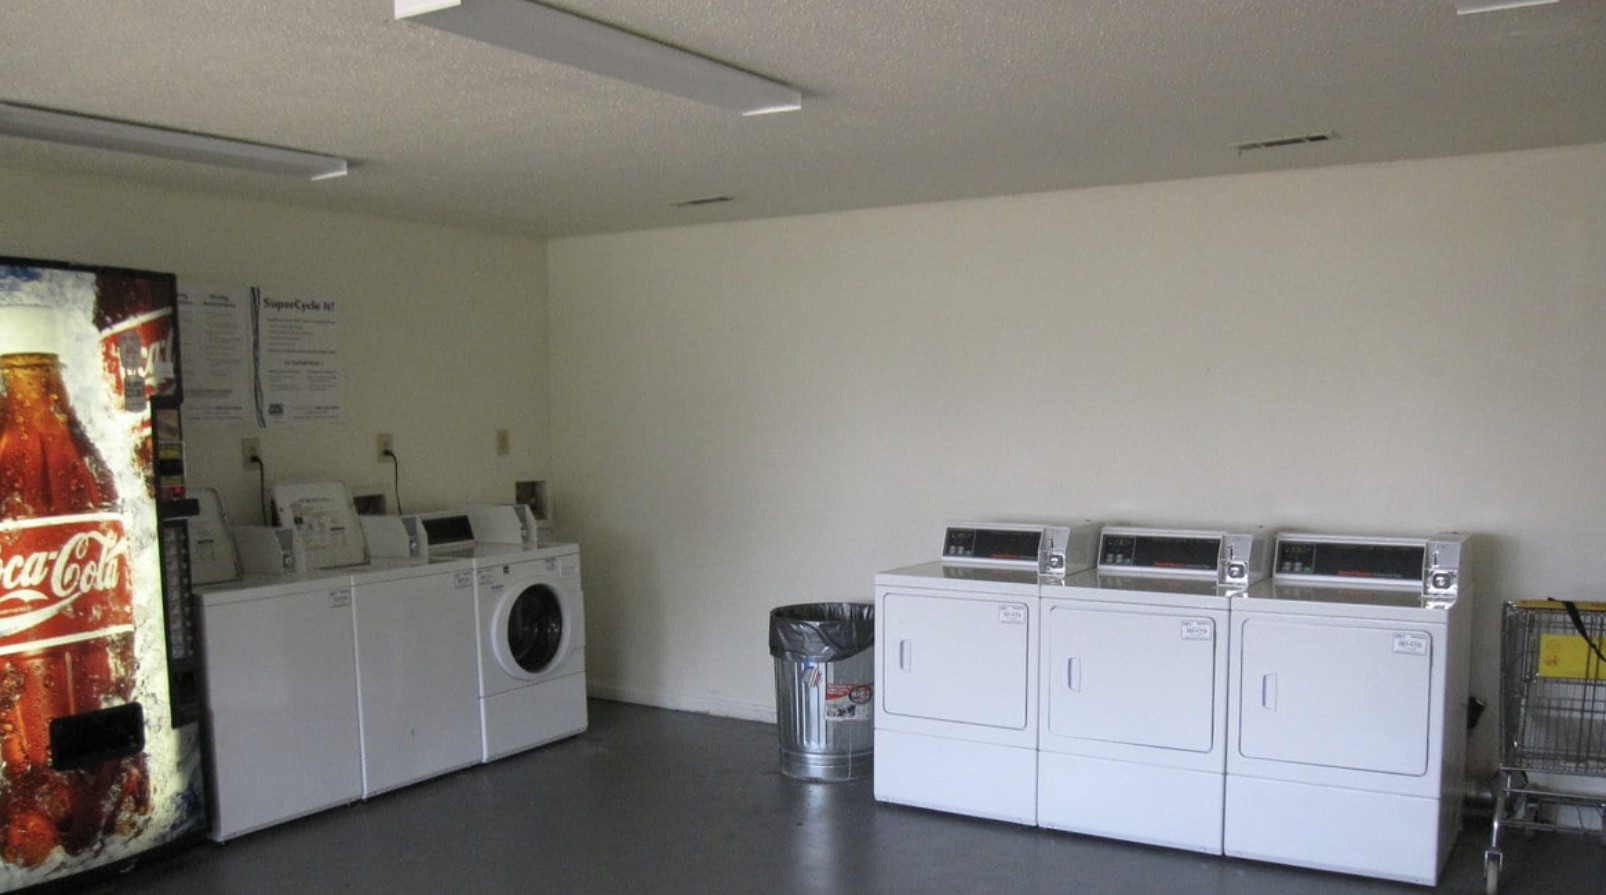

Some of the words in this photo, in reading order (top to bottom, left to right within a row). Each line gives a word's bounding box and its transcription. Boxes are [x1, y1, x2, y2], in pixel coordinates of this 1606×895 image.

[263, 297, 320, 312] SuperCycle
[323, 300, 335, 311] It!
[0, 530, 127, 597] ca-Cola
